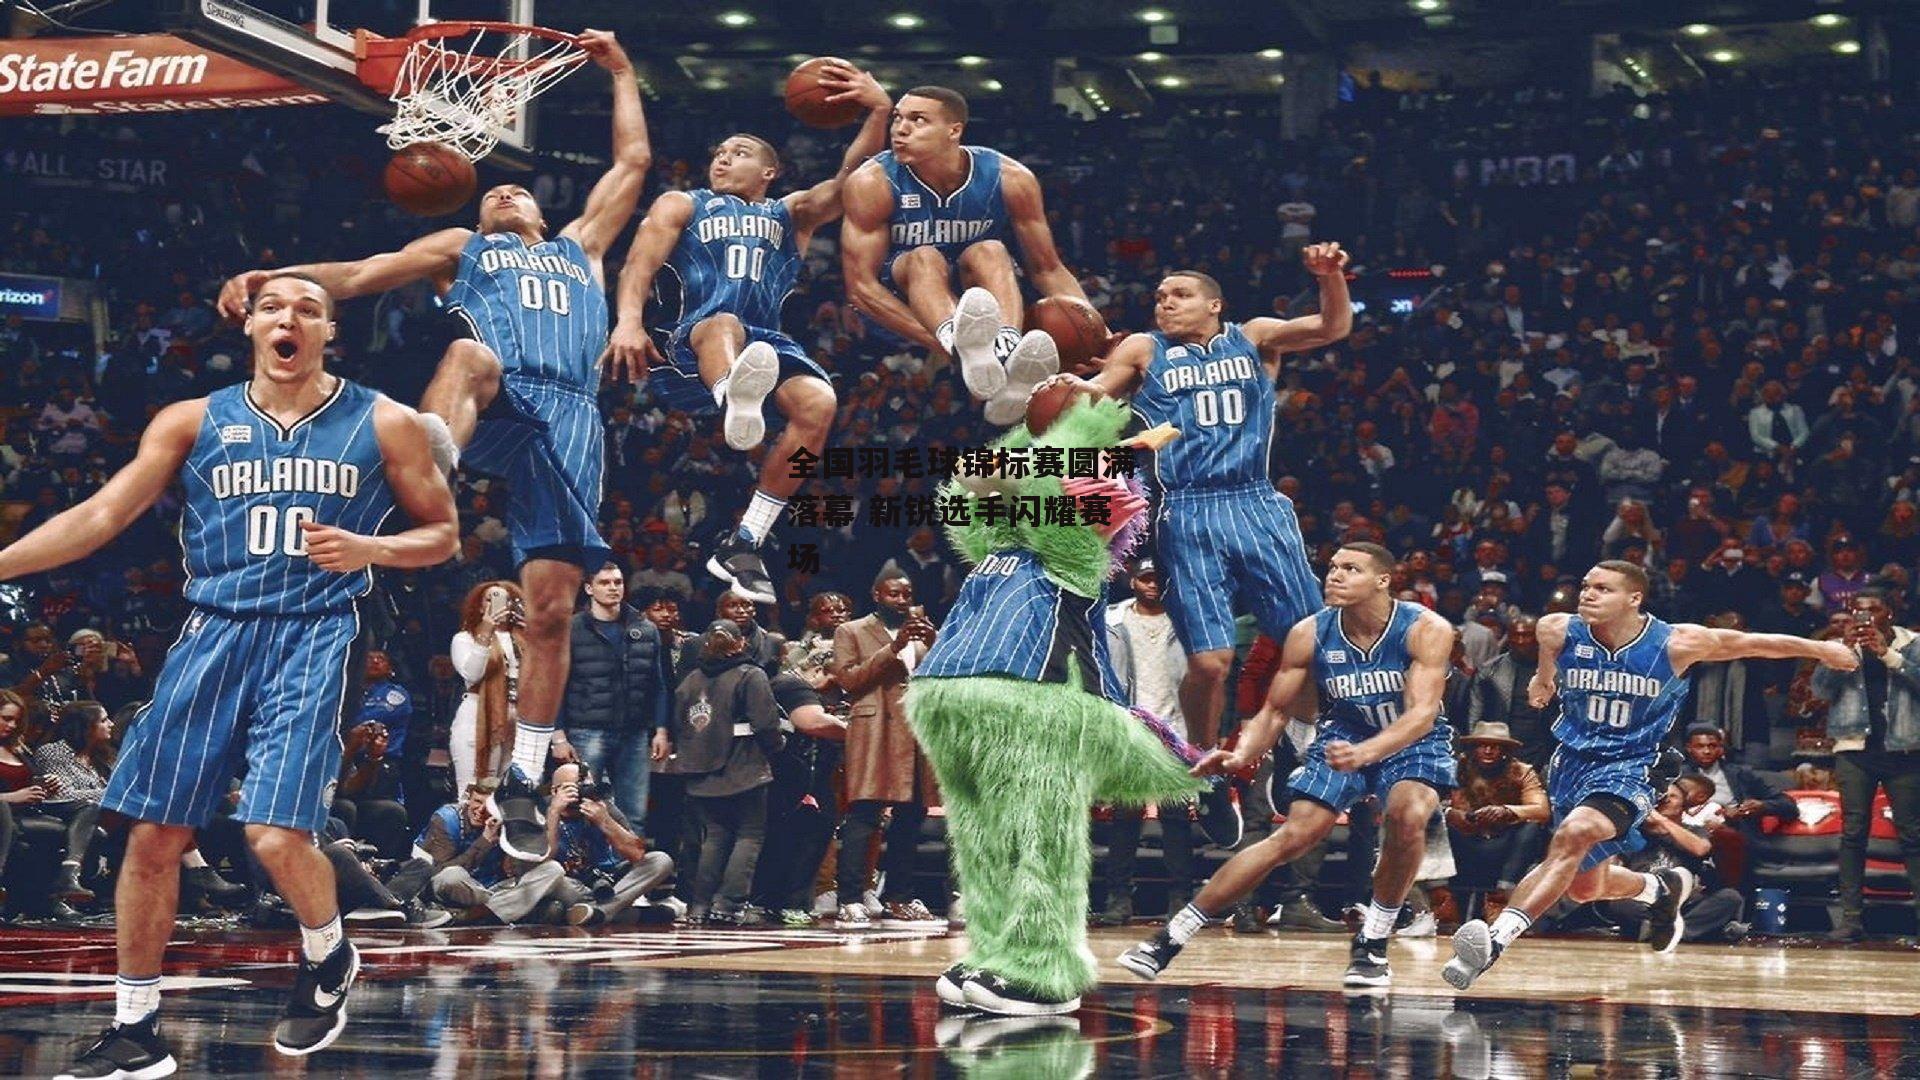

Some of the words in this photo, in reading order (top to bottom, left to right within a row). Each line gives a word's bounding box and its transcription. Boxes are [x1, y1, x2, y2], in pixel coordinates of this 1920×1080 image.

[22, 150, 71, 175] ALL
[98, 158, 167, 186] STAR
[480, 249, 590, 287] ORLANDO
[727, 244, 766, 283] 00
[519, 274, 570, 316] 00
[1163, 355, 1254, 394] ORLAND
[1196, 388, 1244, 427] 00
[211, 457, 360, 500] ORLANDO
[249, 505, 314, 557] 00
[1325, 670, 1405, 699] ORLAND
[1566, 668, 1661, 698] ORLANDO
[1588, 695, 1630, 728] 00
